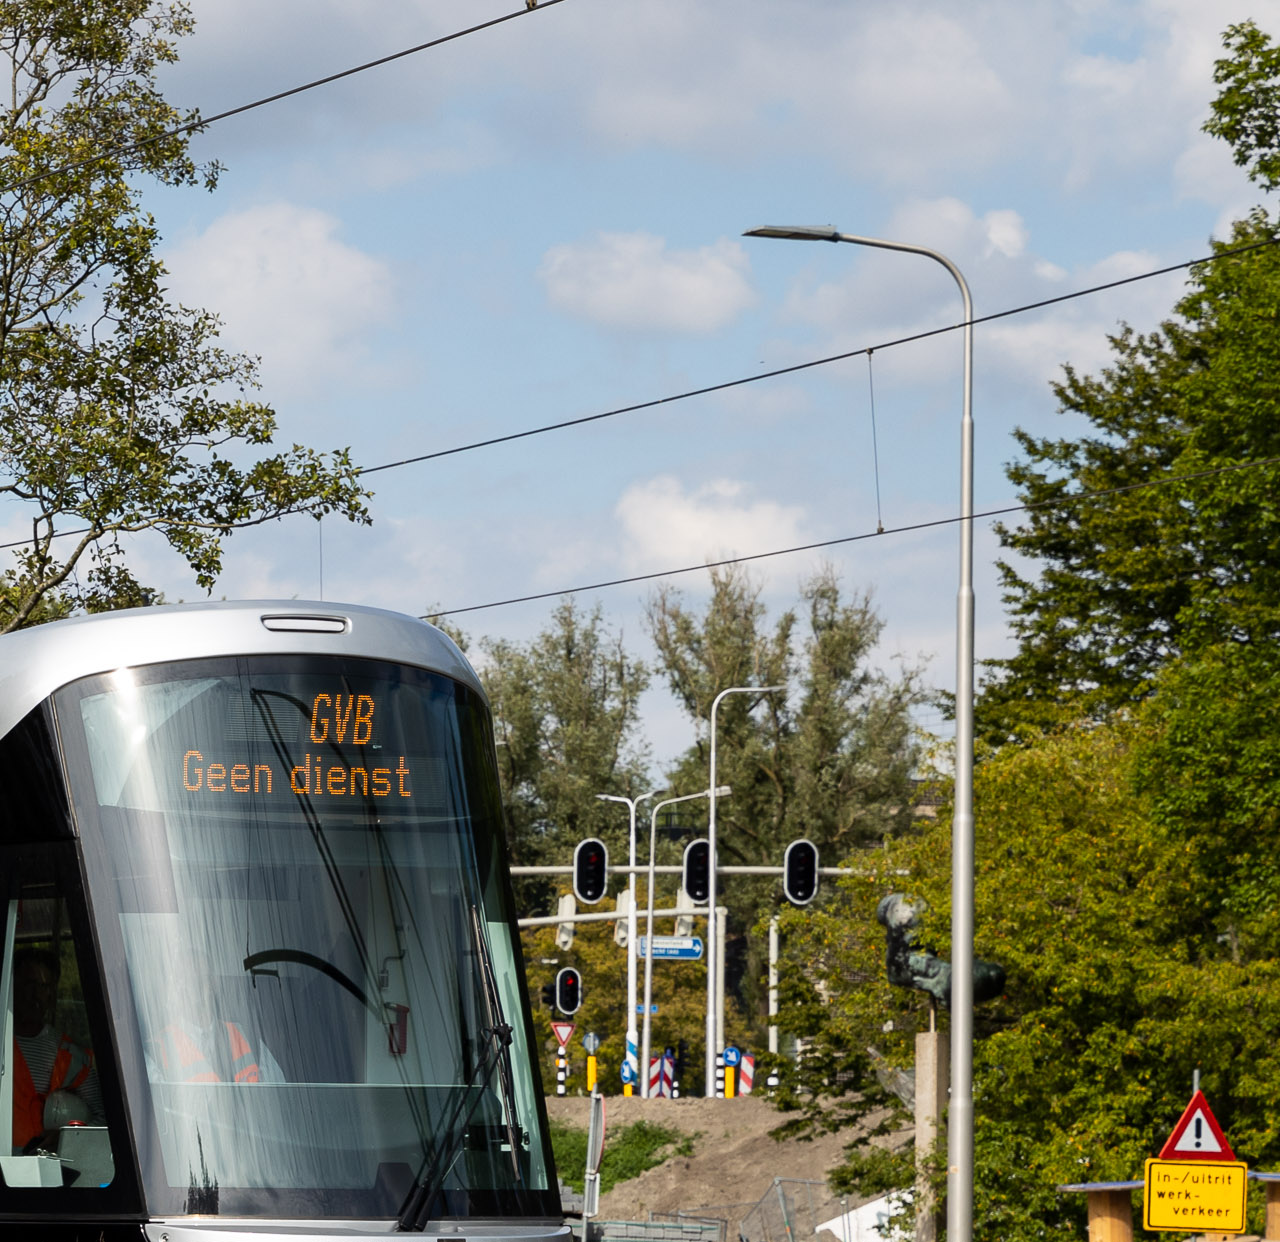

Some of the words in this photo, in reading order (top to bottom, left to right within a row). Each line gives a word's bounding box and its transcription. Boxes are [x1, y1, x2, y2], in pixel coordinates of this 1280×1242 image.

[310, 693, 375, 745] GVB
[183, 750, 272, 793] Geen
[291, 753, 411, 797] dienst
[1157, 1171, 1232, 1185] in-/uitrit
[1157, 1189, 1200, 1200] werk-
[1173, 1206, 1231, 1217] verkeer
